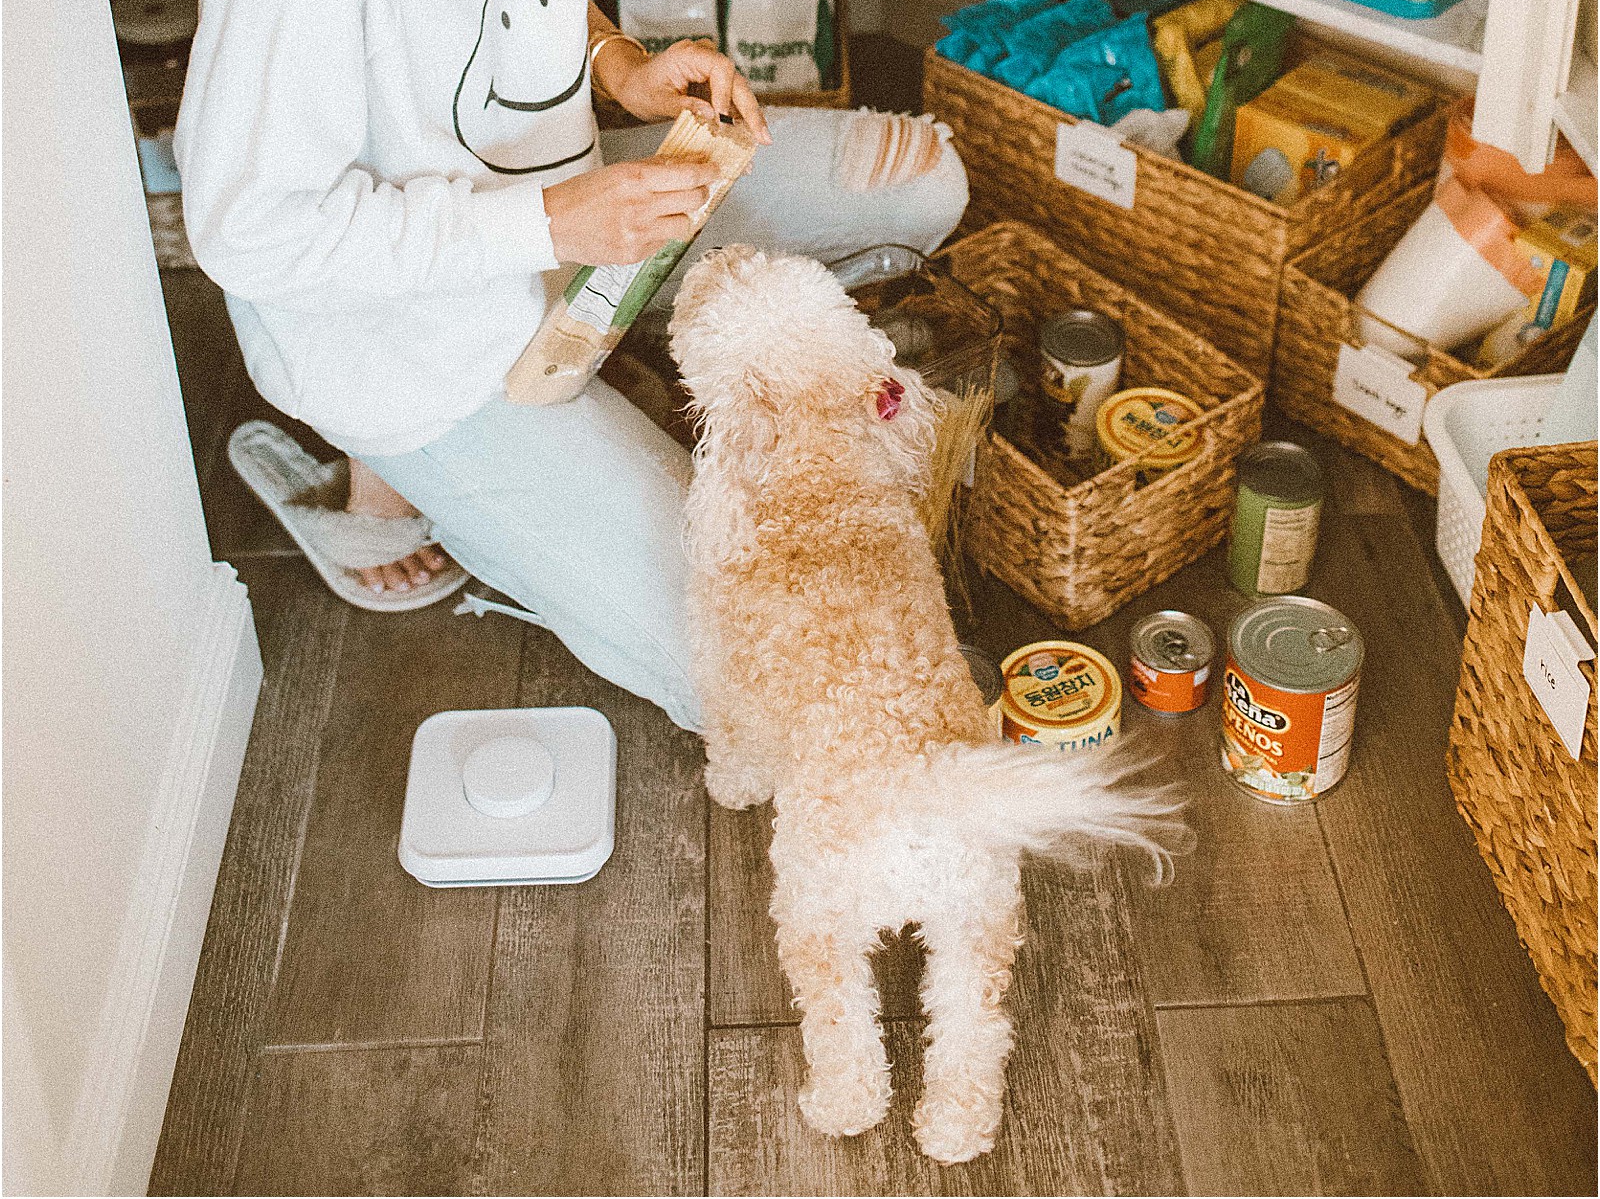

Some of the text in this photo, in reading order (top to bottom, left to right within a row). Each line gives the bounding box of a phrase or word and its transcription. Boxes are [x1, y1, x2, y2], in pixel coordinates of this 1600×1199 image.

[736, 39, 814, 60] epsom
[1230, 674, 1246, 700] La
[1540, 658, 1556, 691] rice
[1056, 724, 1113, 751] TUNA
